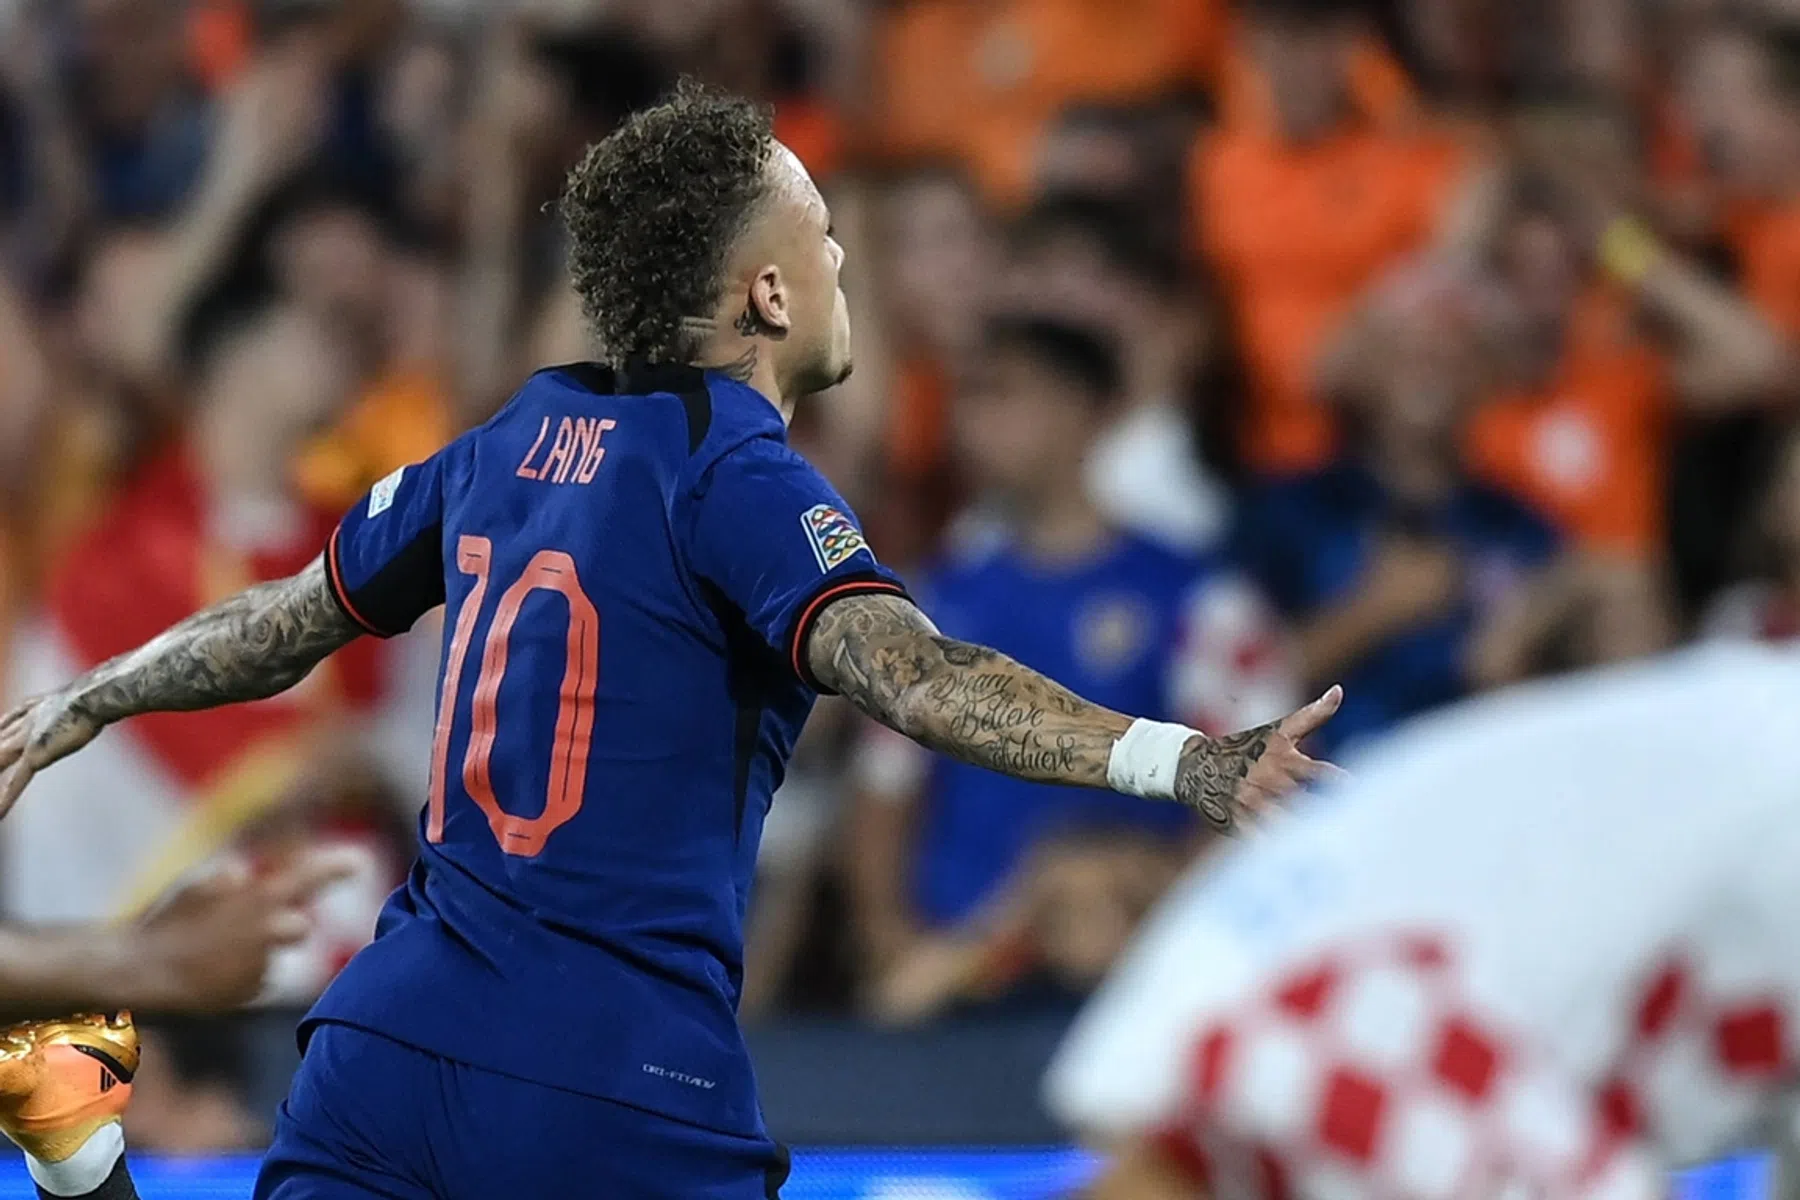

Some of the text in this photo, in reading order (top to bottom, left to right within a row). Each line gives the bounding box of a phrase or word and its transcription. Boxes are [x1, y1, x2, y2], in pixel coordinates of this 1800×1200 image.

[516, 416, 616, 484] LANG
[426, 534, 599, 857] 10
[950, 697, 1045, 740] Believe
